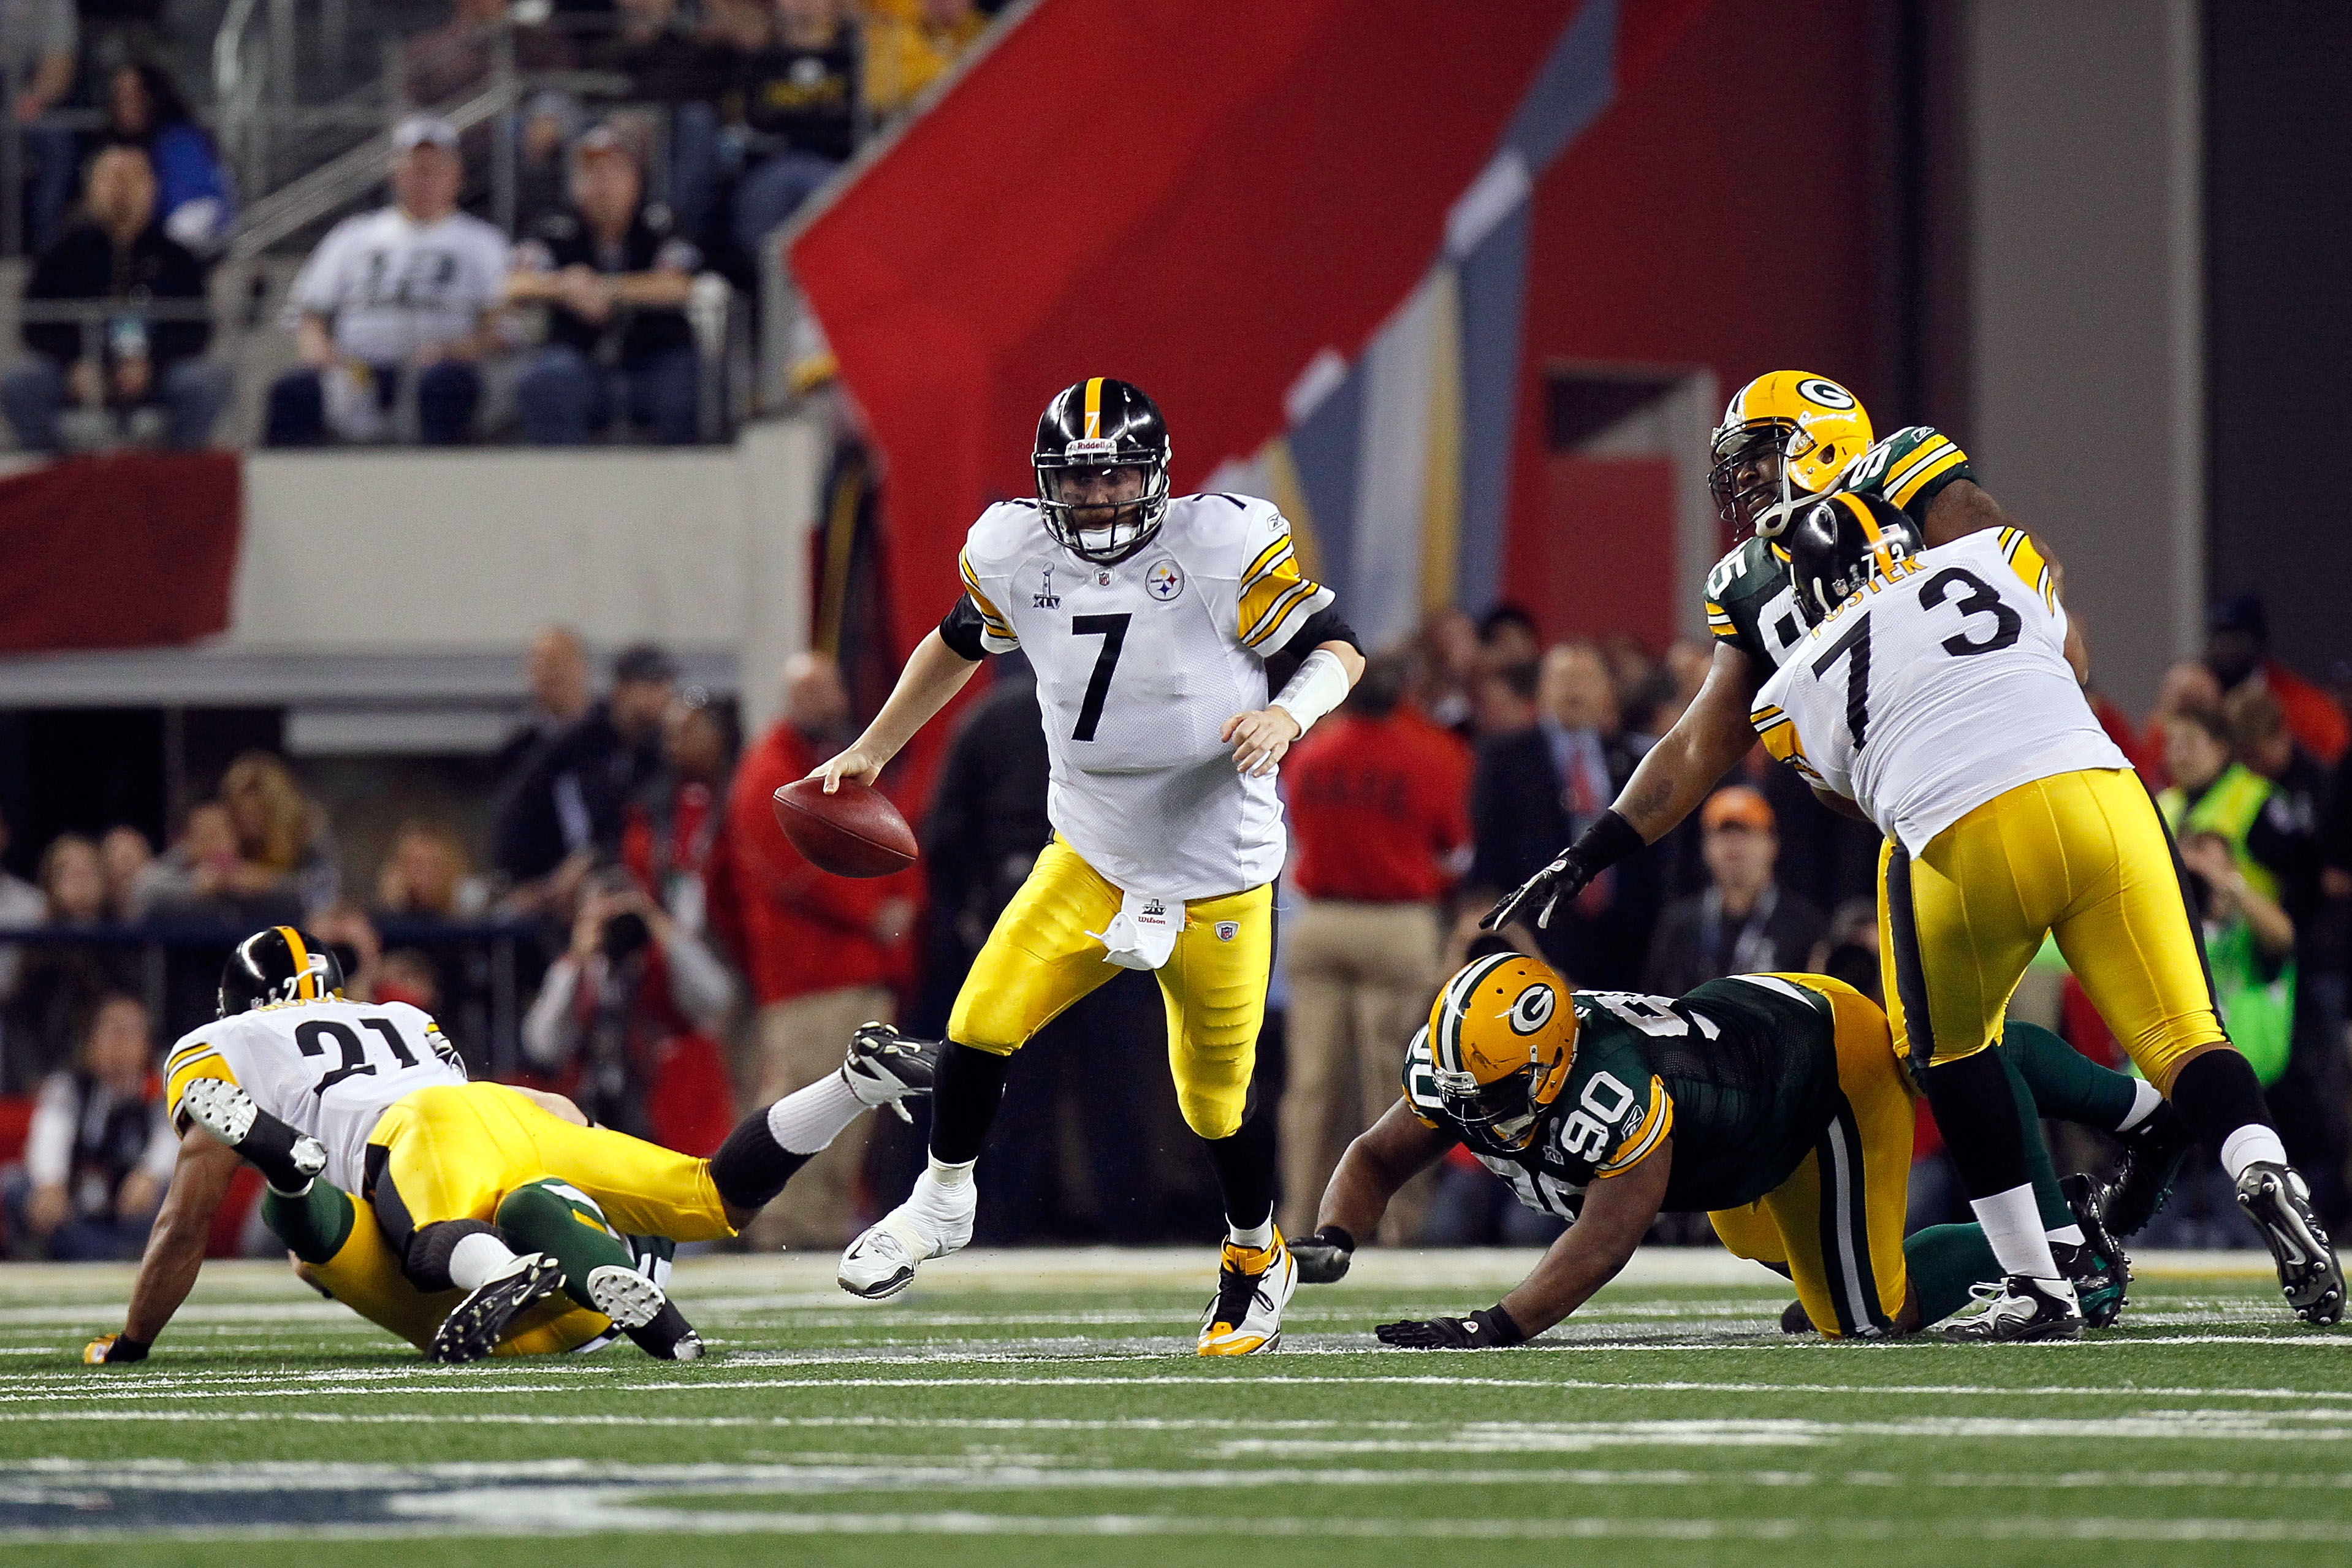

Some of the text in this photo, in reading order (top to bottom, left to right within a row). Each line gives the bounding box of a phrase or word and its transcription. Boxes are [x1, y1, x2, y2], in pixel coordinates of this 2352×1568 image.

[1800, 379, 1855, 409] G
[1084, 411, 1100, 440] 7
[1071, 613, 1133, 742] 7
[1138, 916, 1166, 925] Wilson
[283, 975, 324, 1002] 21
[1513, 986, 1554, 1032] G
[295, 1017, 419, 1097] 21
[1561, 1071, 1634, 1163] 90
